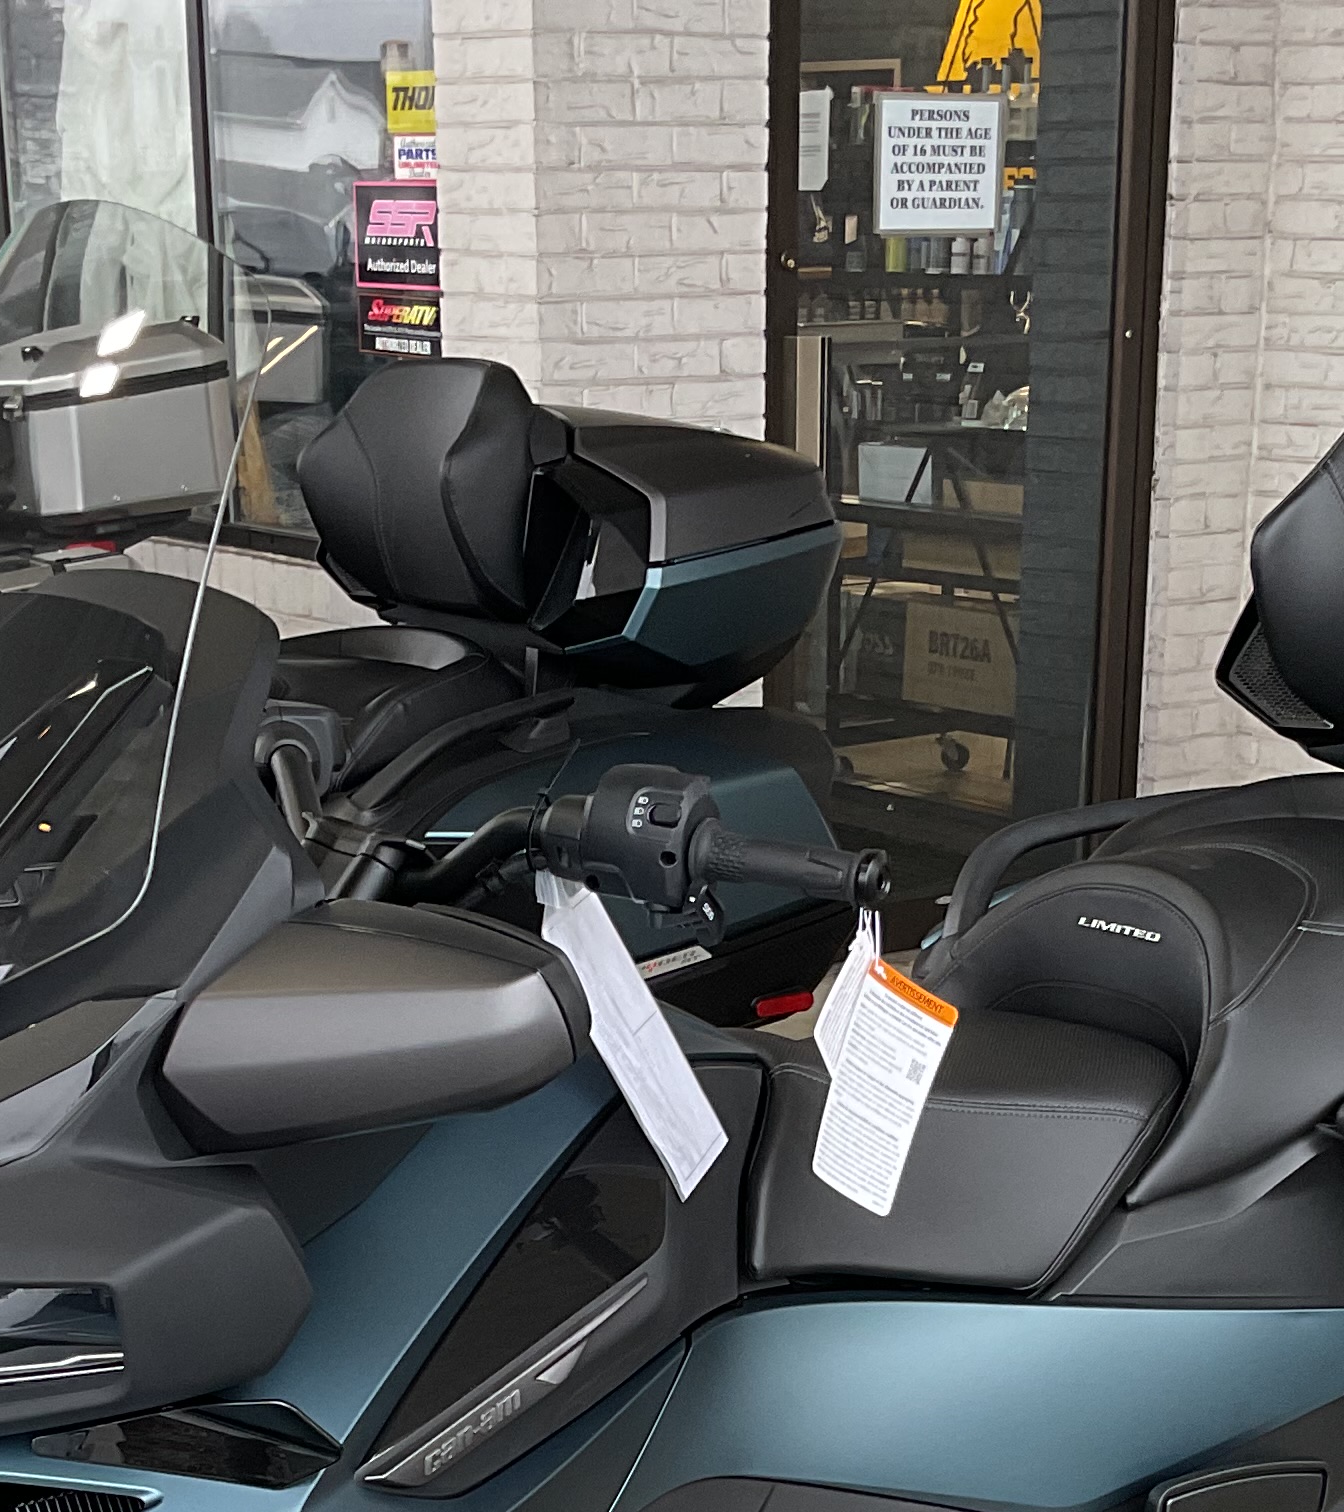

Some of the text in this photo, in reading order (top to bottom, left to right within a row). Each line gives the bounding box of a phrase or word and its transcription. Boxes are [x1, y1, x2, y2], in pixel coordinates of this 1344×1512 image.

[910, 108, 970, 122] PERSONS
[887, 126, 992, 140] UNDER THE AGE
[891, 144, 986, 158] OF 16 MUST BE
[890, 162, 986, 175] ACCOMPANIED
[896, 179, 980, 192] BY A PARENT
[890, 197, 985, 210] OR GUARDIAN.
[366, 200, 436, 247] SSR
[367, 258, 437, 274] Authorized Dealer
[1077, 916, 1161, 943] LIMITED
[889, 975, 945, 1014] AVERTISSEMENT
